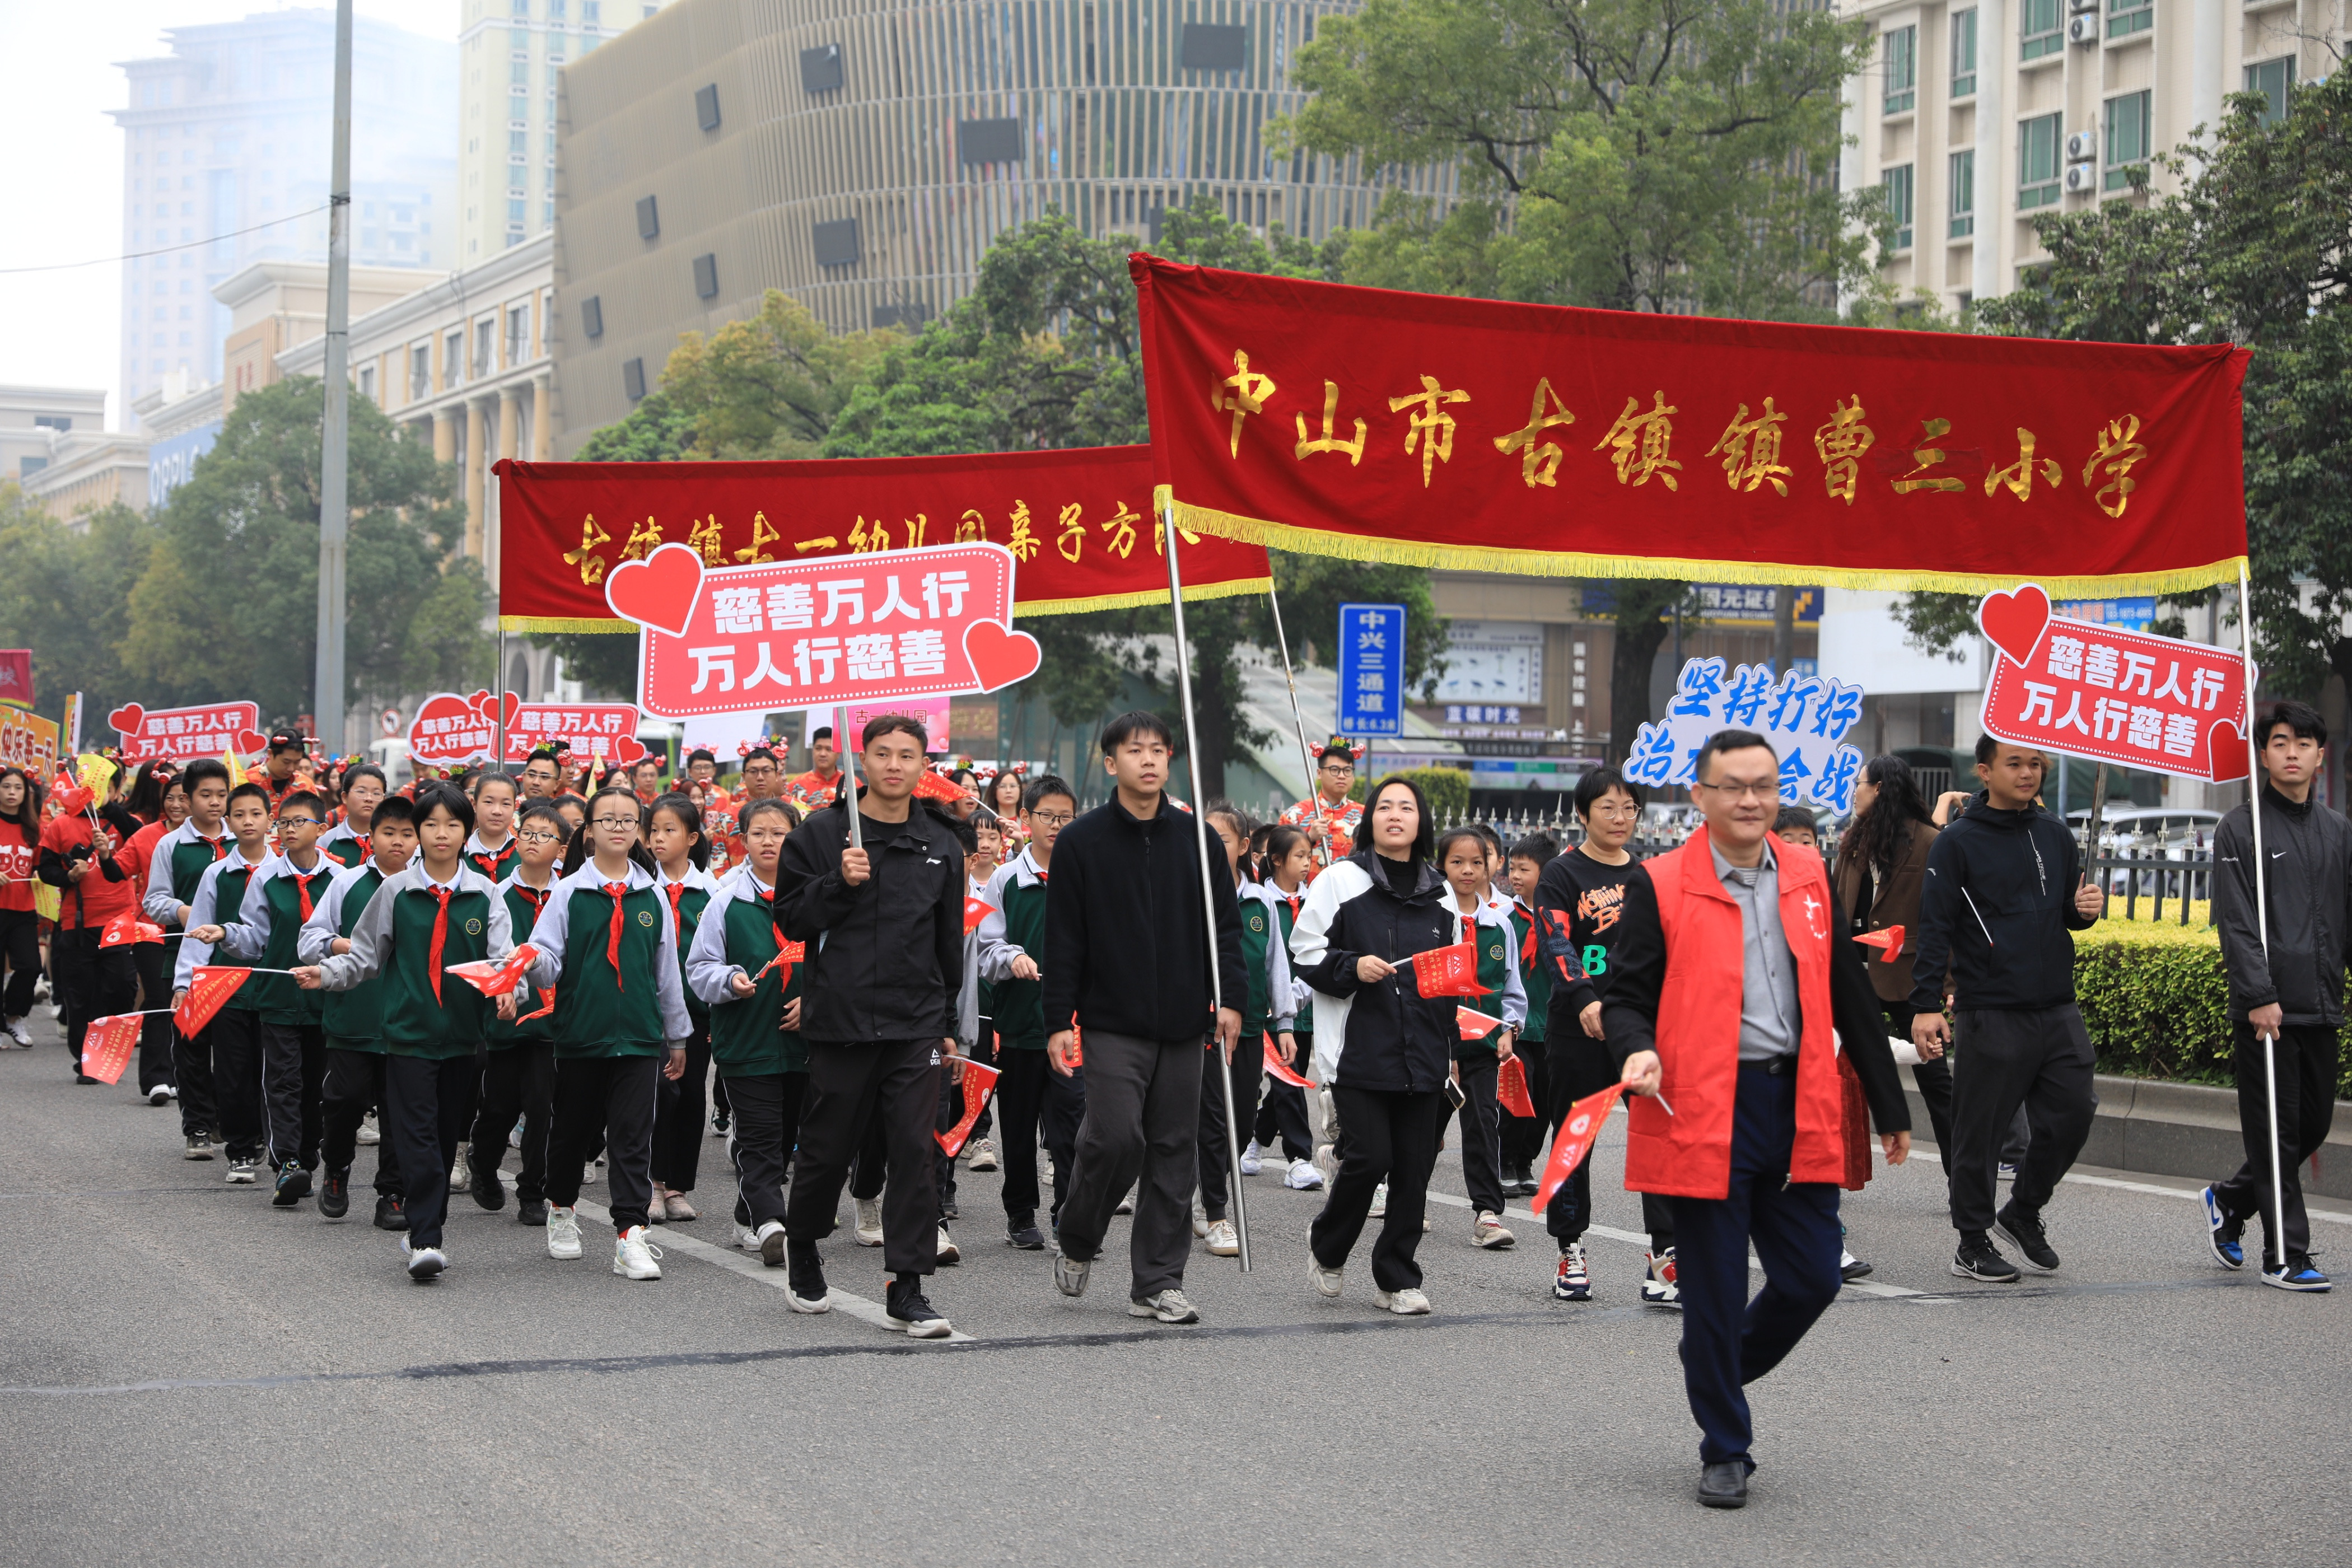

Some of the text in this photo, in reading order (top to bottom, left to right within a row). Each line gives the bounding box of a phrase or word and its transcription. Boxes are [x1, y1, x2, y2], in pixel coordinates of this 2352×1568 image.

[1211, 348, 2148, 519] 中山市古镇镇曹三小学
[713, 570, 970, 634] 慈善万人行
[688, 630, 945, 694] 万人行慈善
[1356, 610, 1386, 712] 中兴三通道
[2047, 635, 2224, 711] 慈善万人行
[147, 711, 242, 736] 慈善万人行
[521, 711, 623, 734] 慈善万人行
[1673, 666, 1858, 740] 坚持打好
[2019, 680, 2198, 758] 万人行慈善
[138, 732, 234, 757] 万人行慈善
[414, 730, 489, 753] 万人行慈善
